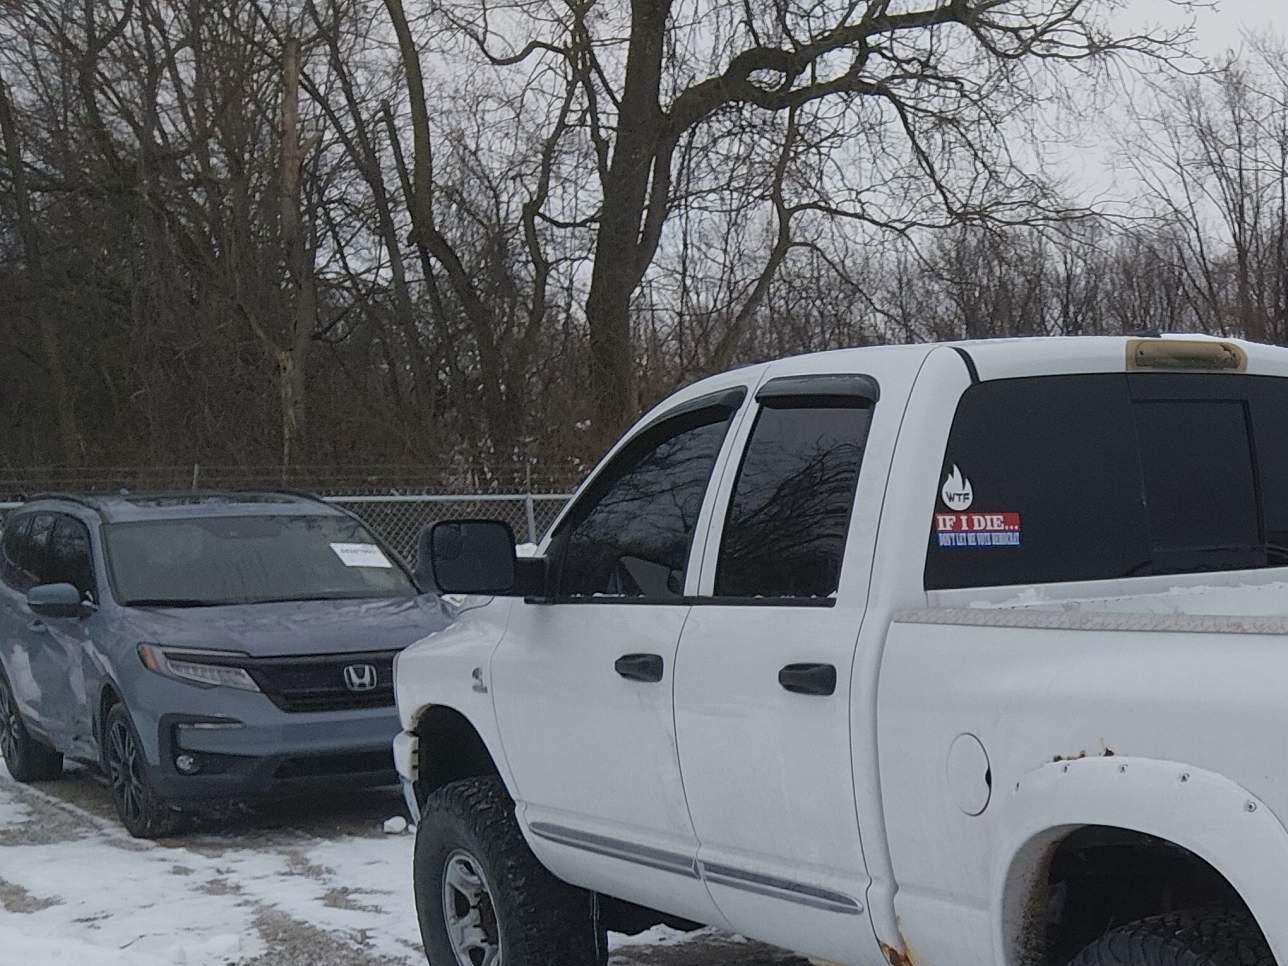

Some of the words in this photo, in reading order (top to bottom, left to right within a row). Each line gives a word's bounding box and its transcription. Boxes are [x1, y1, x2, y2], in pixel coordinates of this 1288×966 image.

[946, 491, 970, 503] WTF
[936, 515, 956, 531] IF
[960, 515, 969, 531] I
[972, 515, 1019, 531] DIE...
